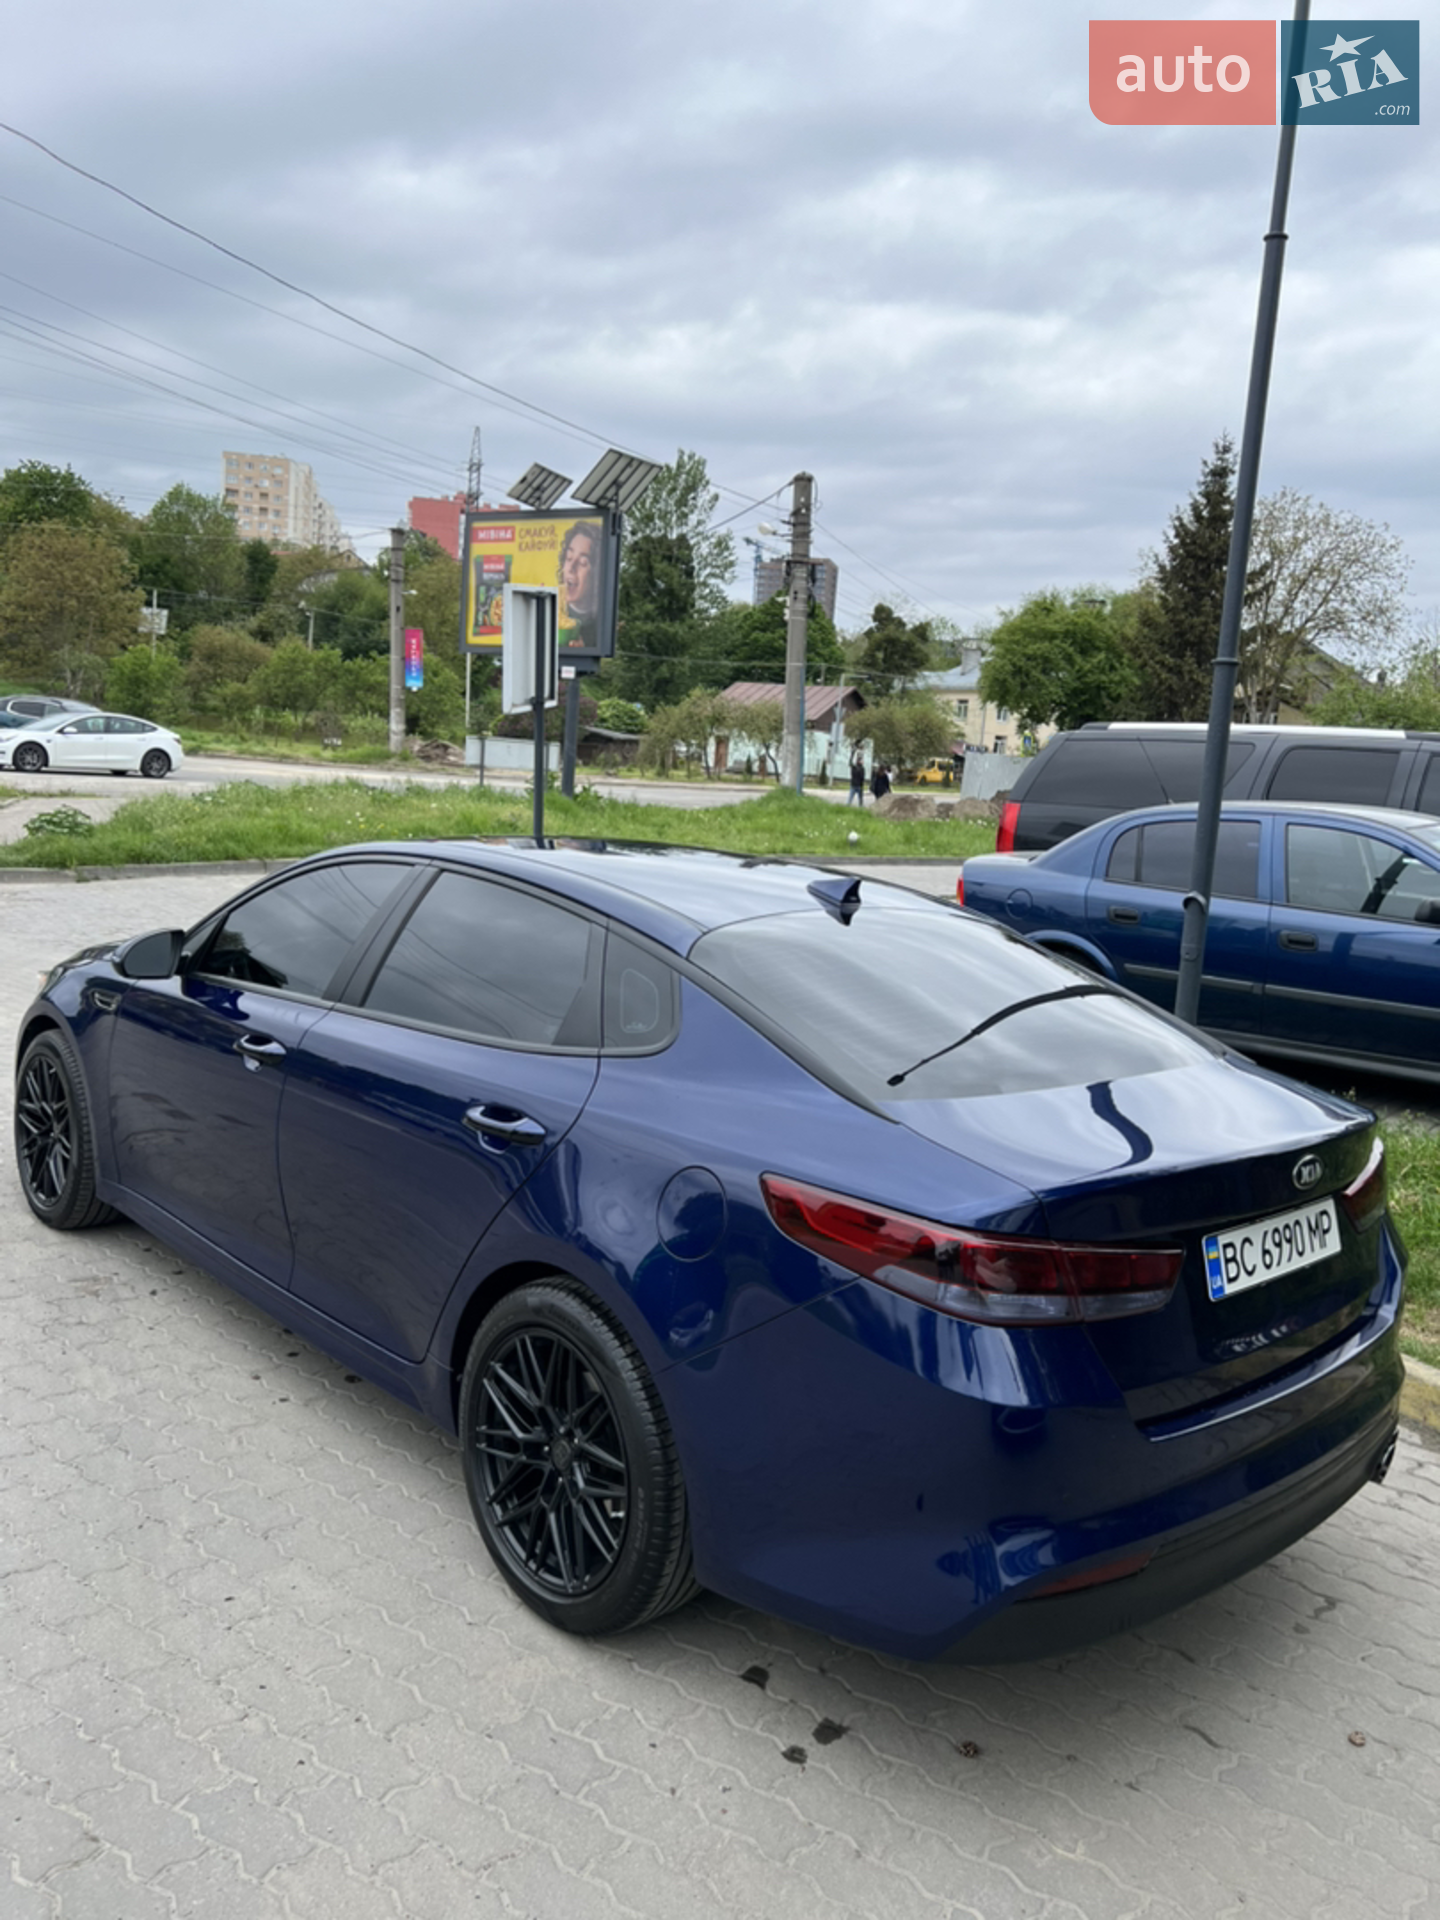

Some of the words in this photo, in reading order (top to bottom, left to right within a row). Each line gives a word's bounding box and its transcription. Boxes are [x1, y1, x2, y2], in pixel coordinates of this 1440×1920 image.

[478, 529, 513, 540] МІВІНА
[1300, 1162, 1321, 1184] KIA
[1222, 1236, 1257, 1284] BC
[1261, 1219, 1305, 1270] 6990
[1306, 1209, 1332, 1253] MP
